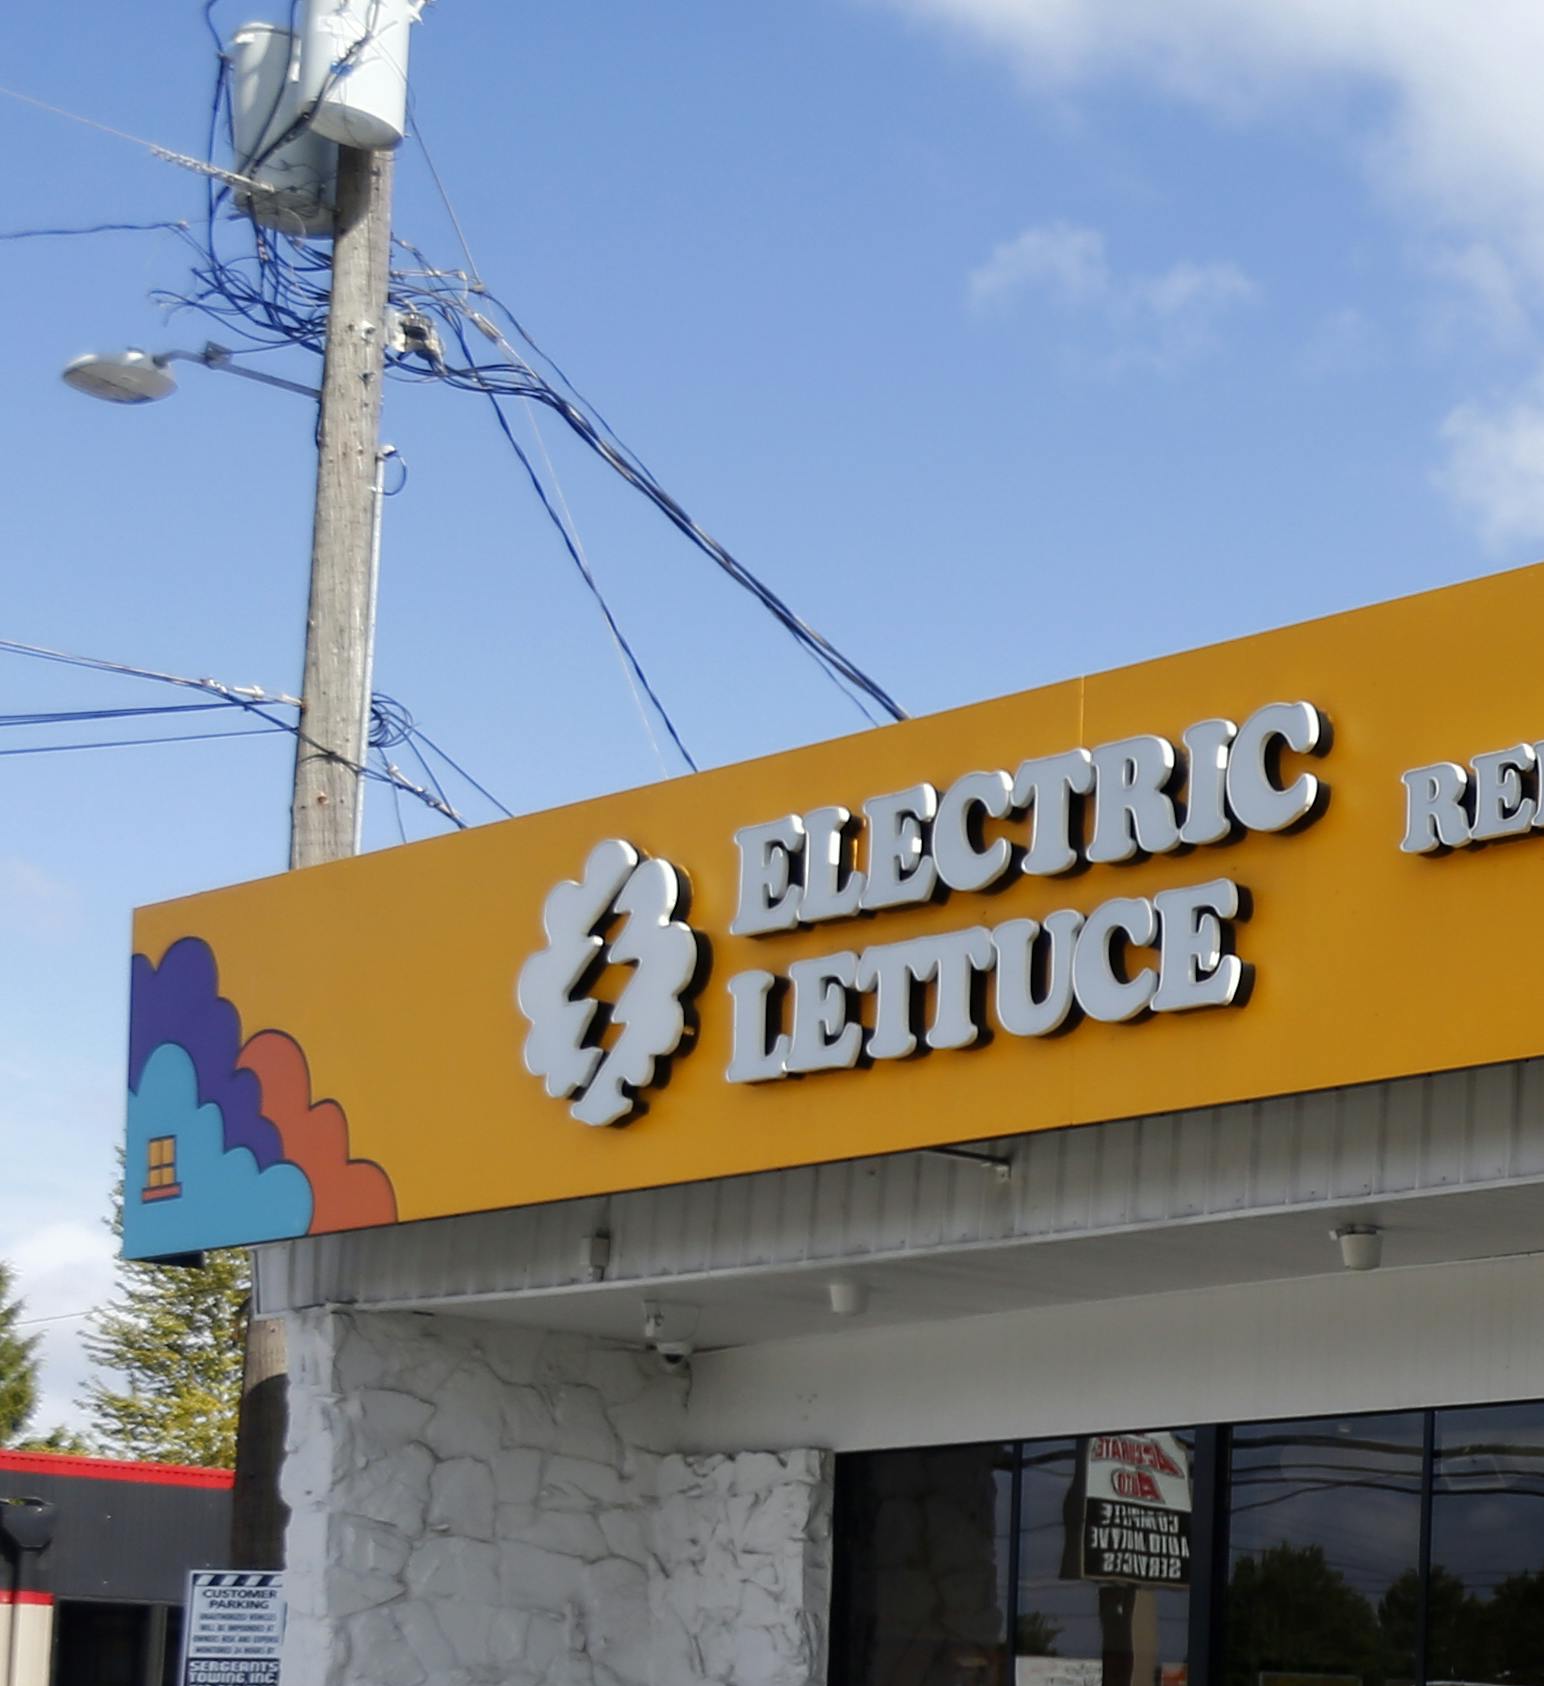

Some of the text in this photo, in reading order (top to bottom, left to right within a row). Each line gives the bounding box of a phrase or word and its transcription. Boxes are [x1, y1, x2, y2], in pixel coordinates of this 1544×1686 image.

[729, 700, 1326, 938] ELECTRIC
[725, 877, 1246, 1084] LETTUCE
[203, 1589, 277, 1599] CUSTOMER
[209, 1600, 269, 1609] PARKING
[189, 1661, 279, 1672] SERGEANTS
